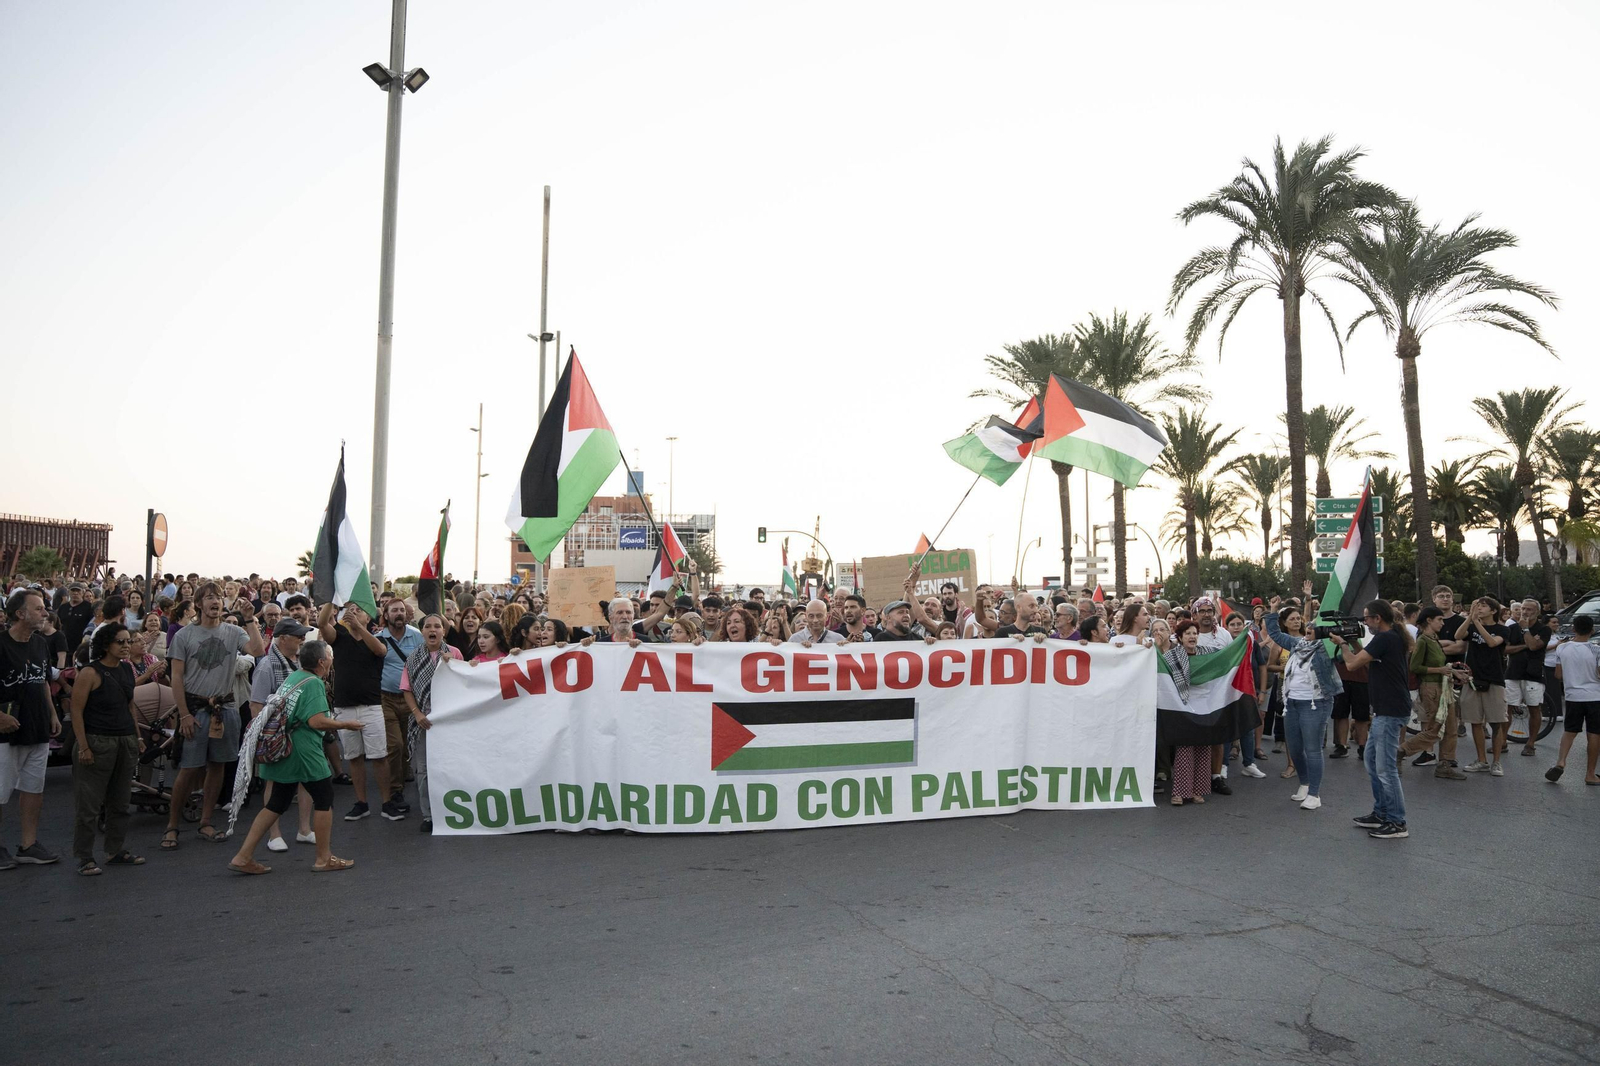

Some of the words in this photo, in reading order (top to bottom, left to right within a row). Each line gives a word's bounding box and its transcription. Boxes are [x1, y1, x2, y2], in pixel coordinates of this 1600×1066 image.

[499, 651, 594, 700] NO
[620, 651, 713, 692] AL
[740, 648, 1091, 692] GENOCIDIO
[443, 782, 778, 830] SOLIDARIDAD
[798, 776, 893, 820] CON
[911, 765, 1143, 813] PALESTINA
